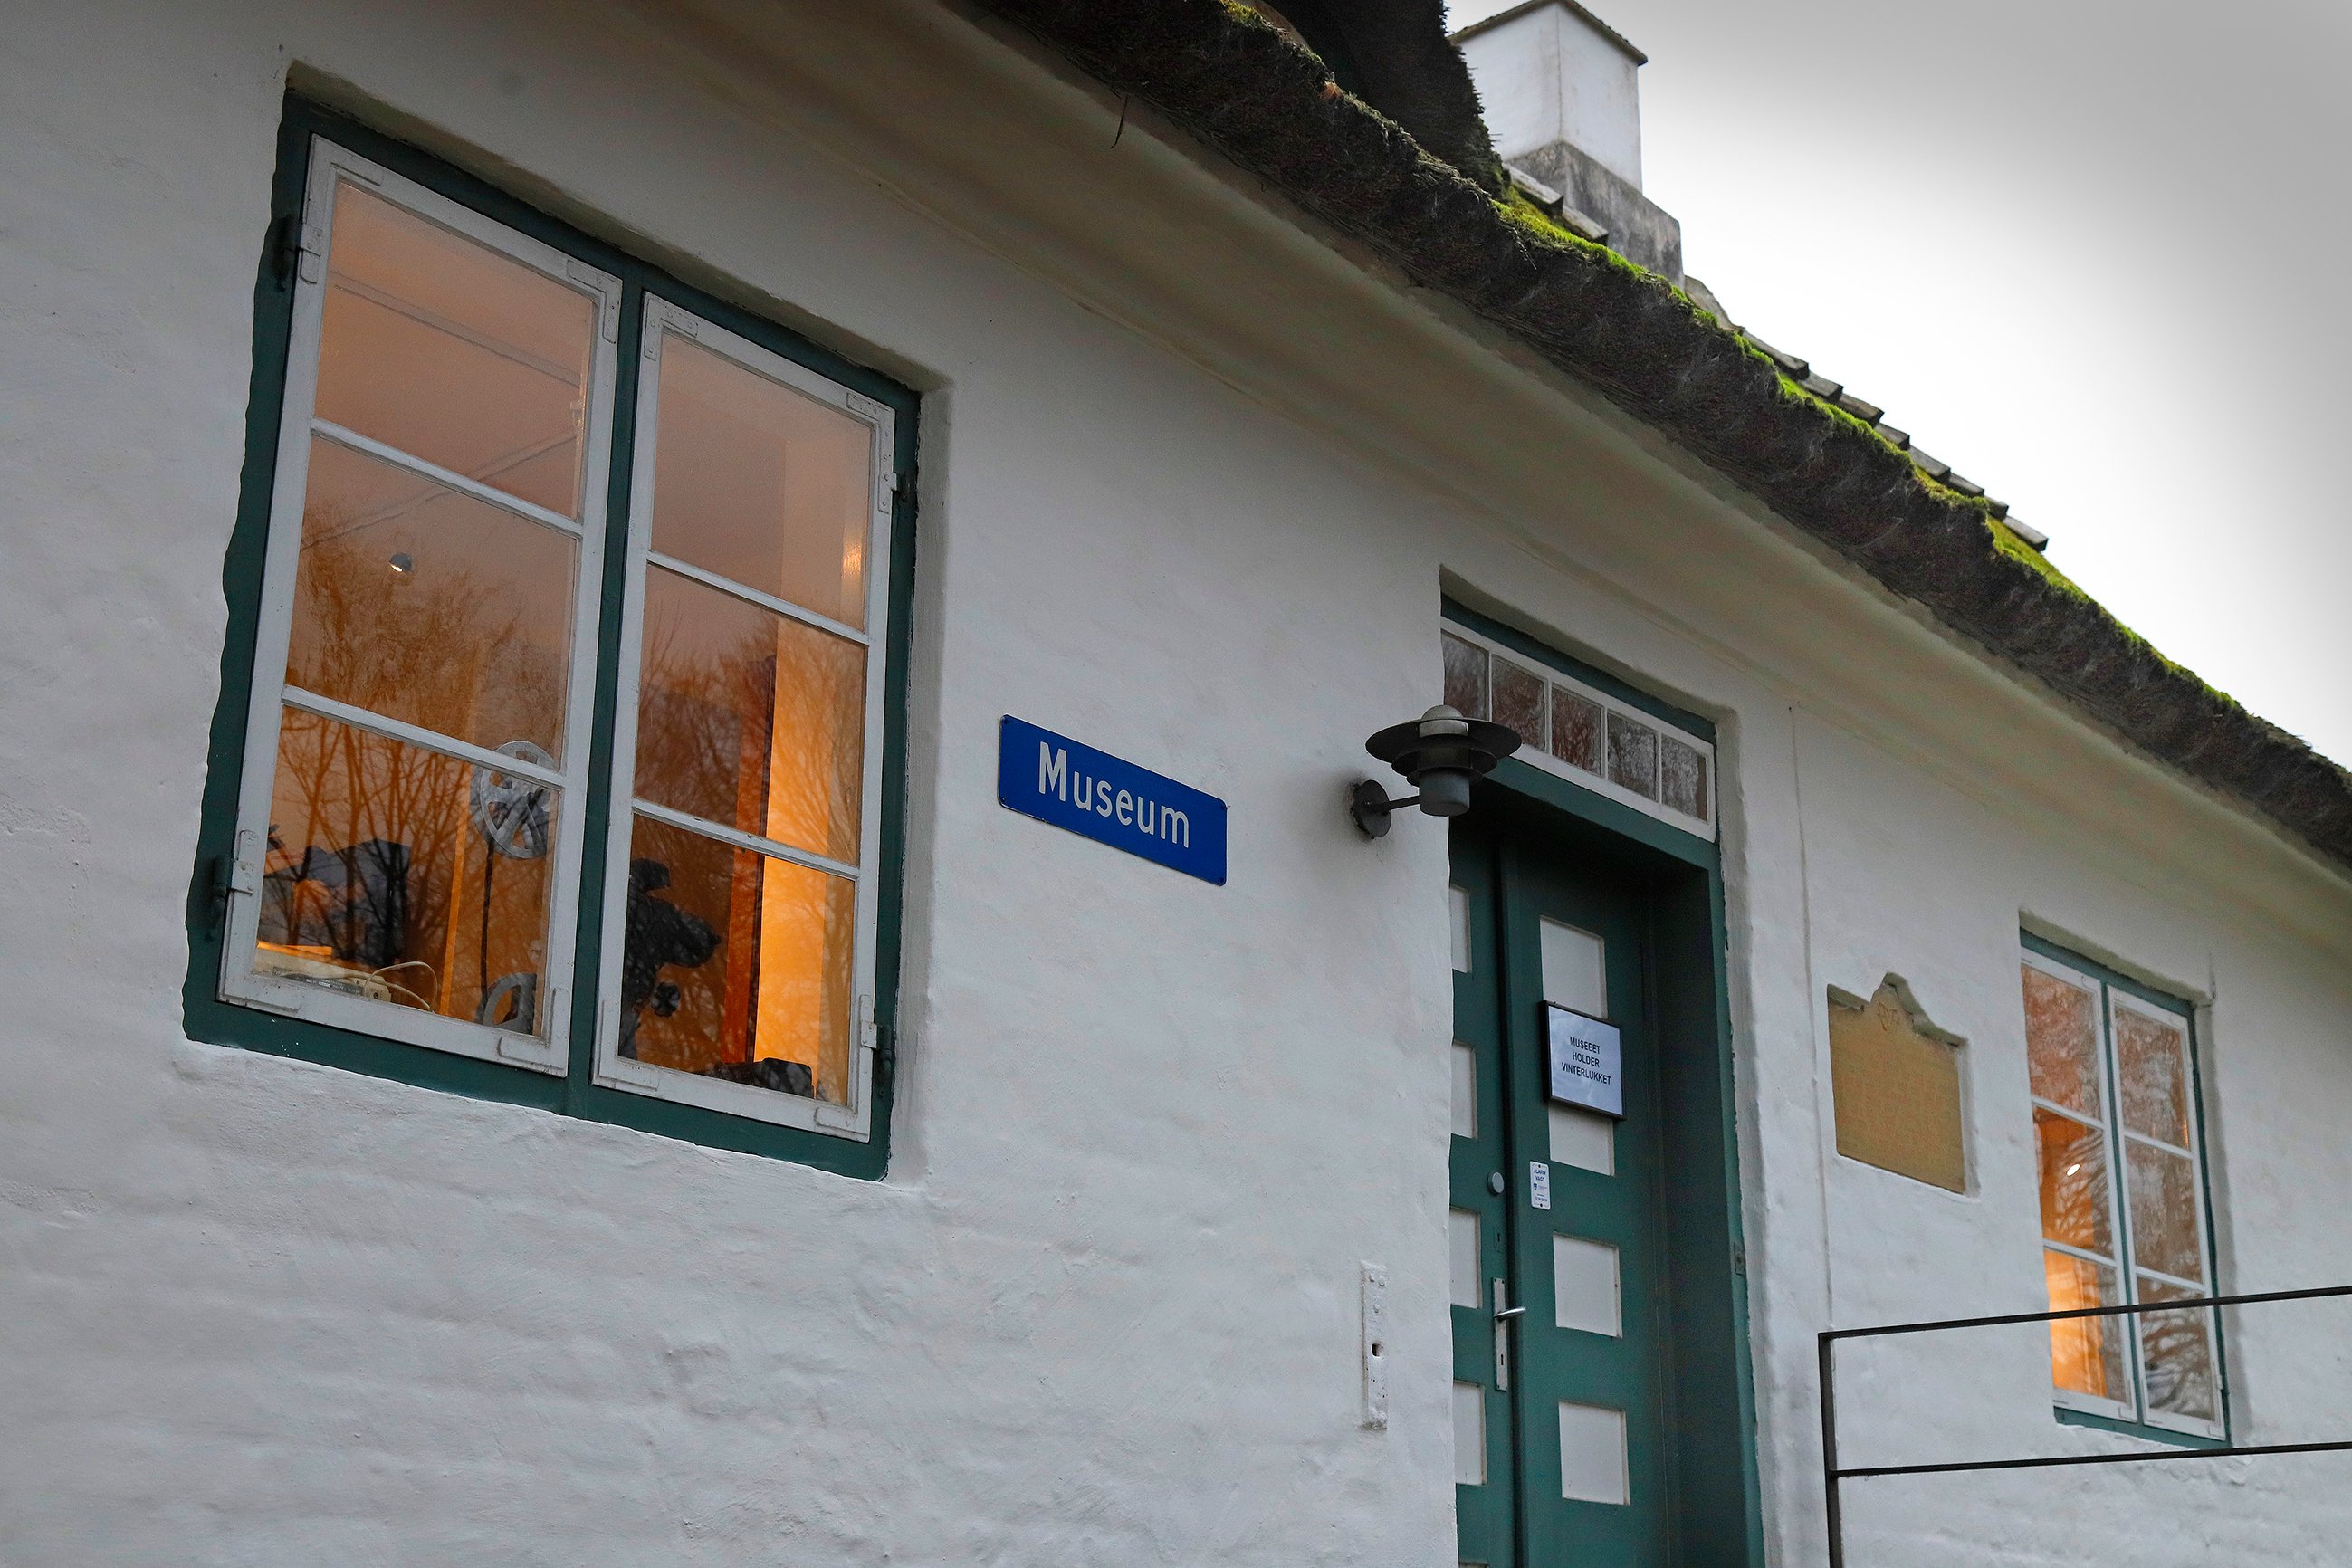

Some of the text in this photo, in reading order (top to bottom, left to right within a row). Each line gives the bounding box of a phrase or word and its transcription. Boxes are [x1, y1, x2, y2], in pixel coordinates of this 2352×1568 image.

[1038, 741, 1190, 849] Museum
[1570, 1037, 1601, 1054] MUSEEET
[1573, 1051, 1600, 1068] HOLDER
[1562, 1062, 1611, 1085] VINTERLUKKET
